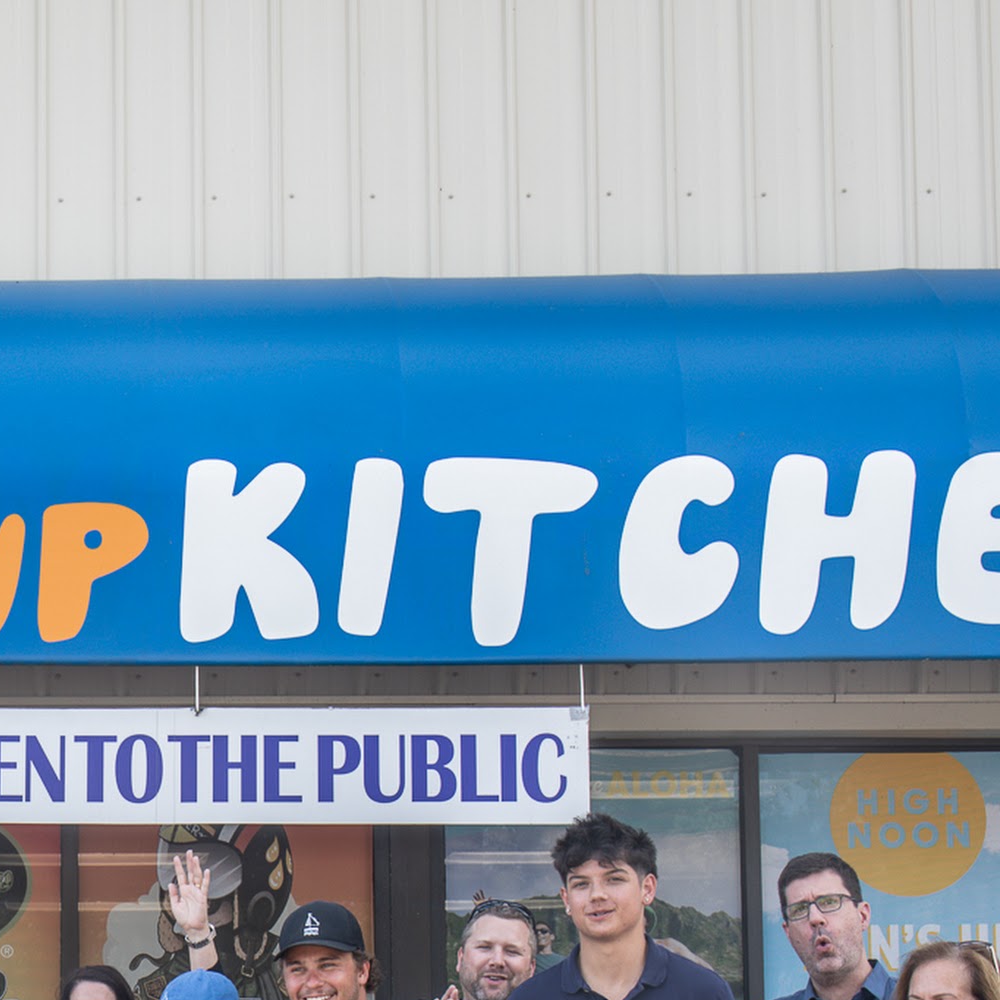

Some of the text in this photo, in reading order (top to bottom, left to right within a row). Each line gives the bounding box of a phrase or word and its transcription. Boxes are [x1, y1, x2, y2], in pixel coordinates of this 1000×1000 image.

[74, 733, 163, 804] TO
[167, 734, 303, 803] THE
[317, 733, 567, 804] PUBLIC
[606, 769, 730, 798] ALOHA
[857, 788, 959, 815] HIGH
[847, 821, 971, 849] NOON
